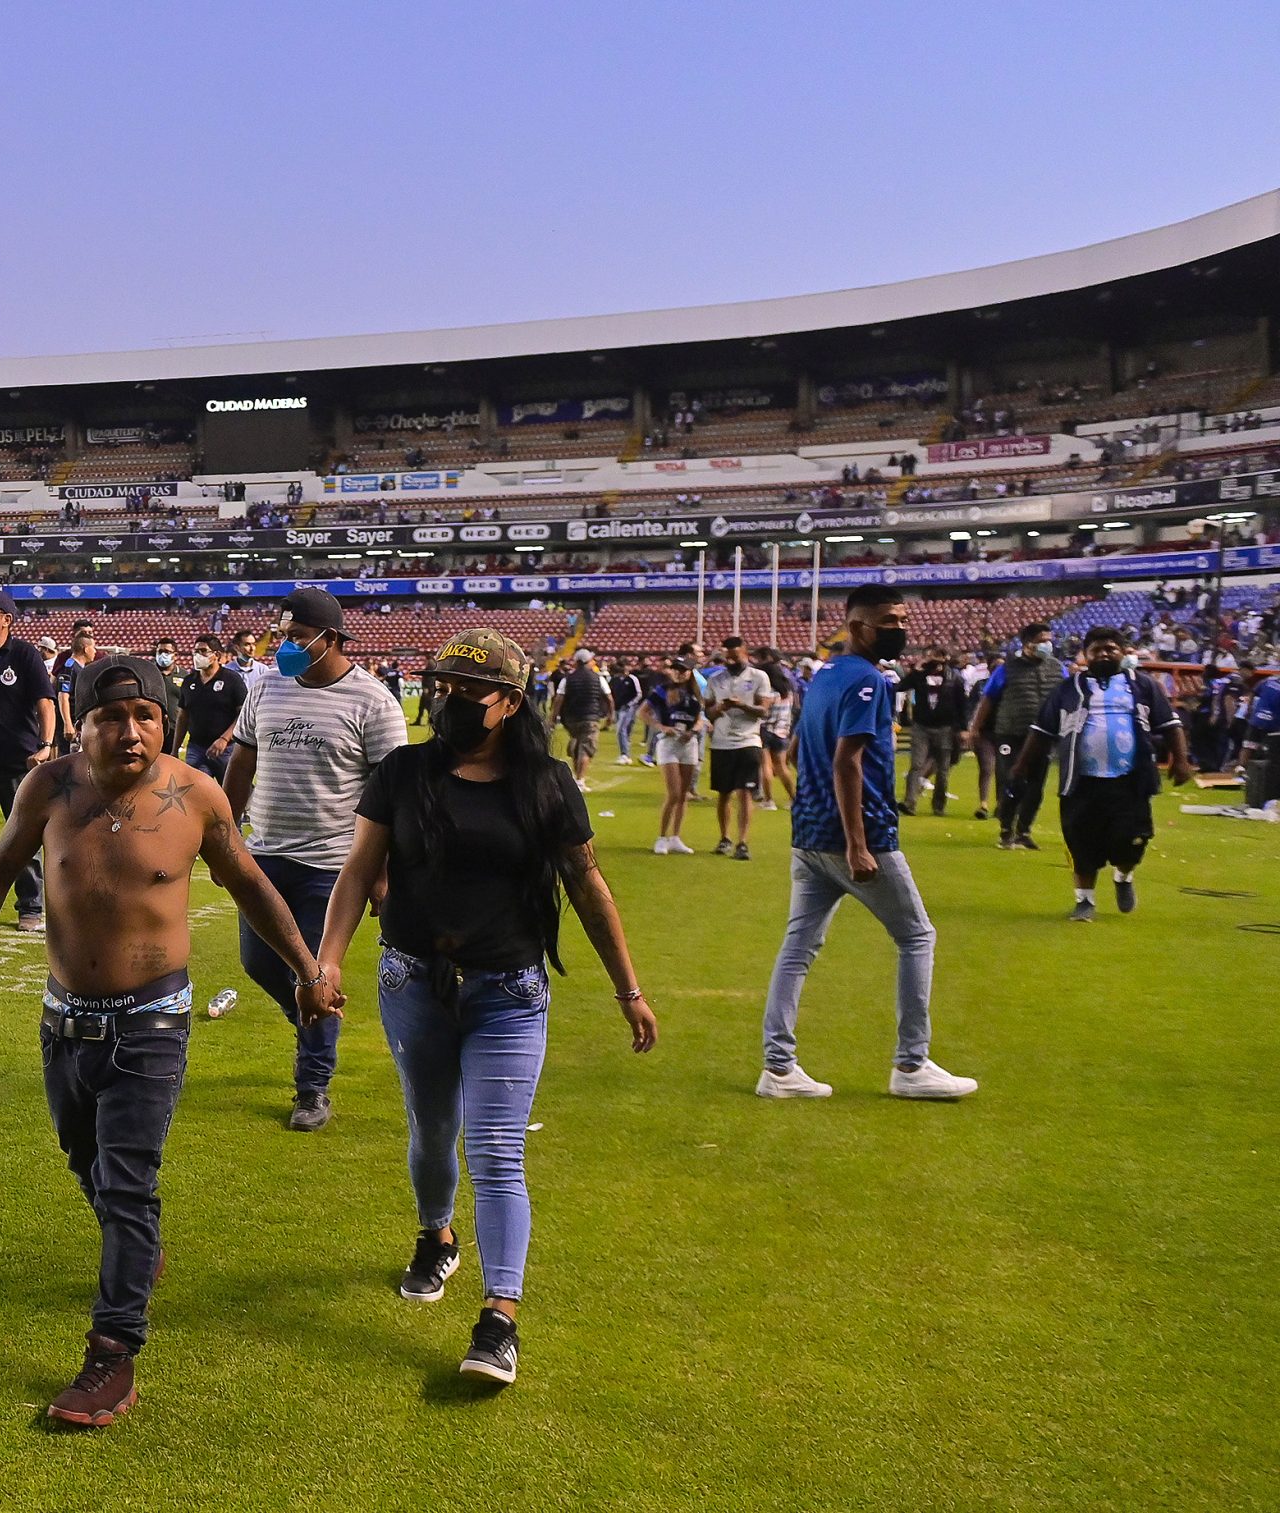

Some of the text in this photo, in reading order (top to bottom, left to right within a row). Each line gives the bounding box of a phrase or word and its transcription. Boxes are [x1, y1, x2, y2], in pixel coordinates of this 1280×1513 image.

[206, 397, 308, 412] CIUDAD MADERAS
[64, 487, 113, 499] CIUDAD
[1114, 489, 1176, 509] Hospital
[346, 528, 393, 546] Sayer
[587, 520, 699, 538] caliente.mx
[286, 530, 331, 547] Sayer
[354, 581, 388, 594] Sayer
[436, 642, 489, 663] LAKERS
[265, 731, 287, 752] The
[66, 992, 135, 1009] Calvin Klein
